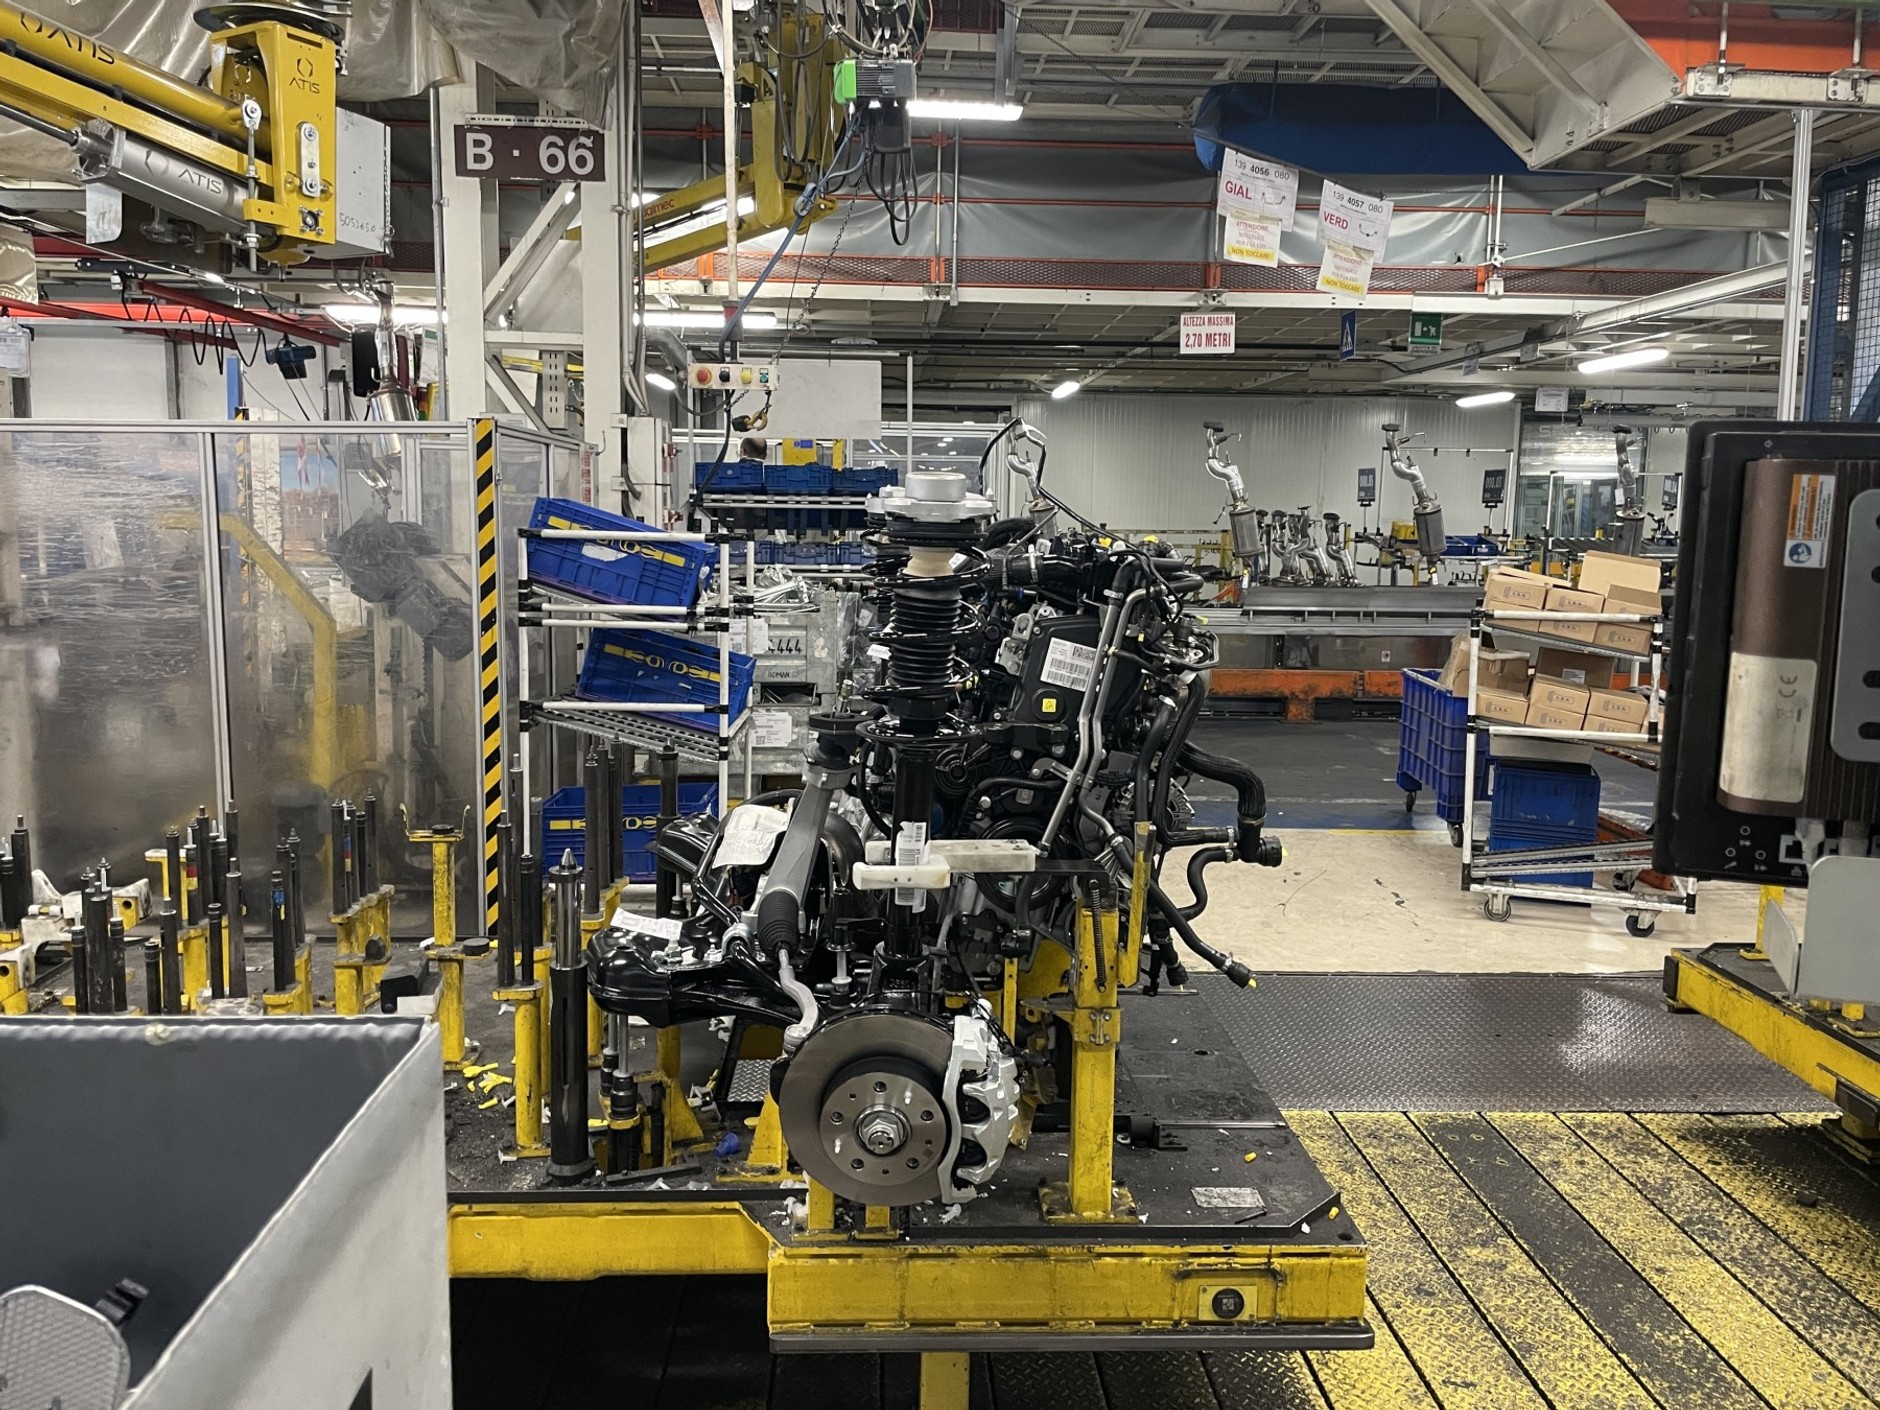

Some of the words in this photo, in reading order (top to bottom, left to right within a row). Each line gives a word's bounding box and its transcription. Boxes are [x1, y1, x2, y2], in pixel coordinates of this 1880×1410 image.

[47, 27, 115, 65] ATIS
[289, 77, 320, 94] ATIS
[466, 132, 494, 171] B
[539, 135, 595, 176] 66
[1234, 159, 1247, 171] 139
[1250, 164, 1270, 177] 4056
[1274, 170, 1290, 180] 080
[178, 168, 223, 195] ATIS
[1225, 180, 1253, 200] GIAL
[1333, 190, 1345, 202] 139
[1347, 197, 1365, 208] 4057
[1368, 203, 1383, 214] 080
[1236, 220, 1269, 231] ATTENZIONE
[1323, 211, 1349, 230] VERD
[1183, 316, 1206, 327] ALTEZZA
[1207, 315, 1233, 326] MASSIMA
[1185, 333, 1203, 349] 2,70
[1205, 333, 1231, 347] METRI
